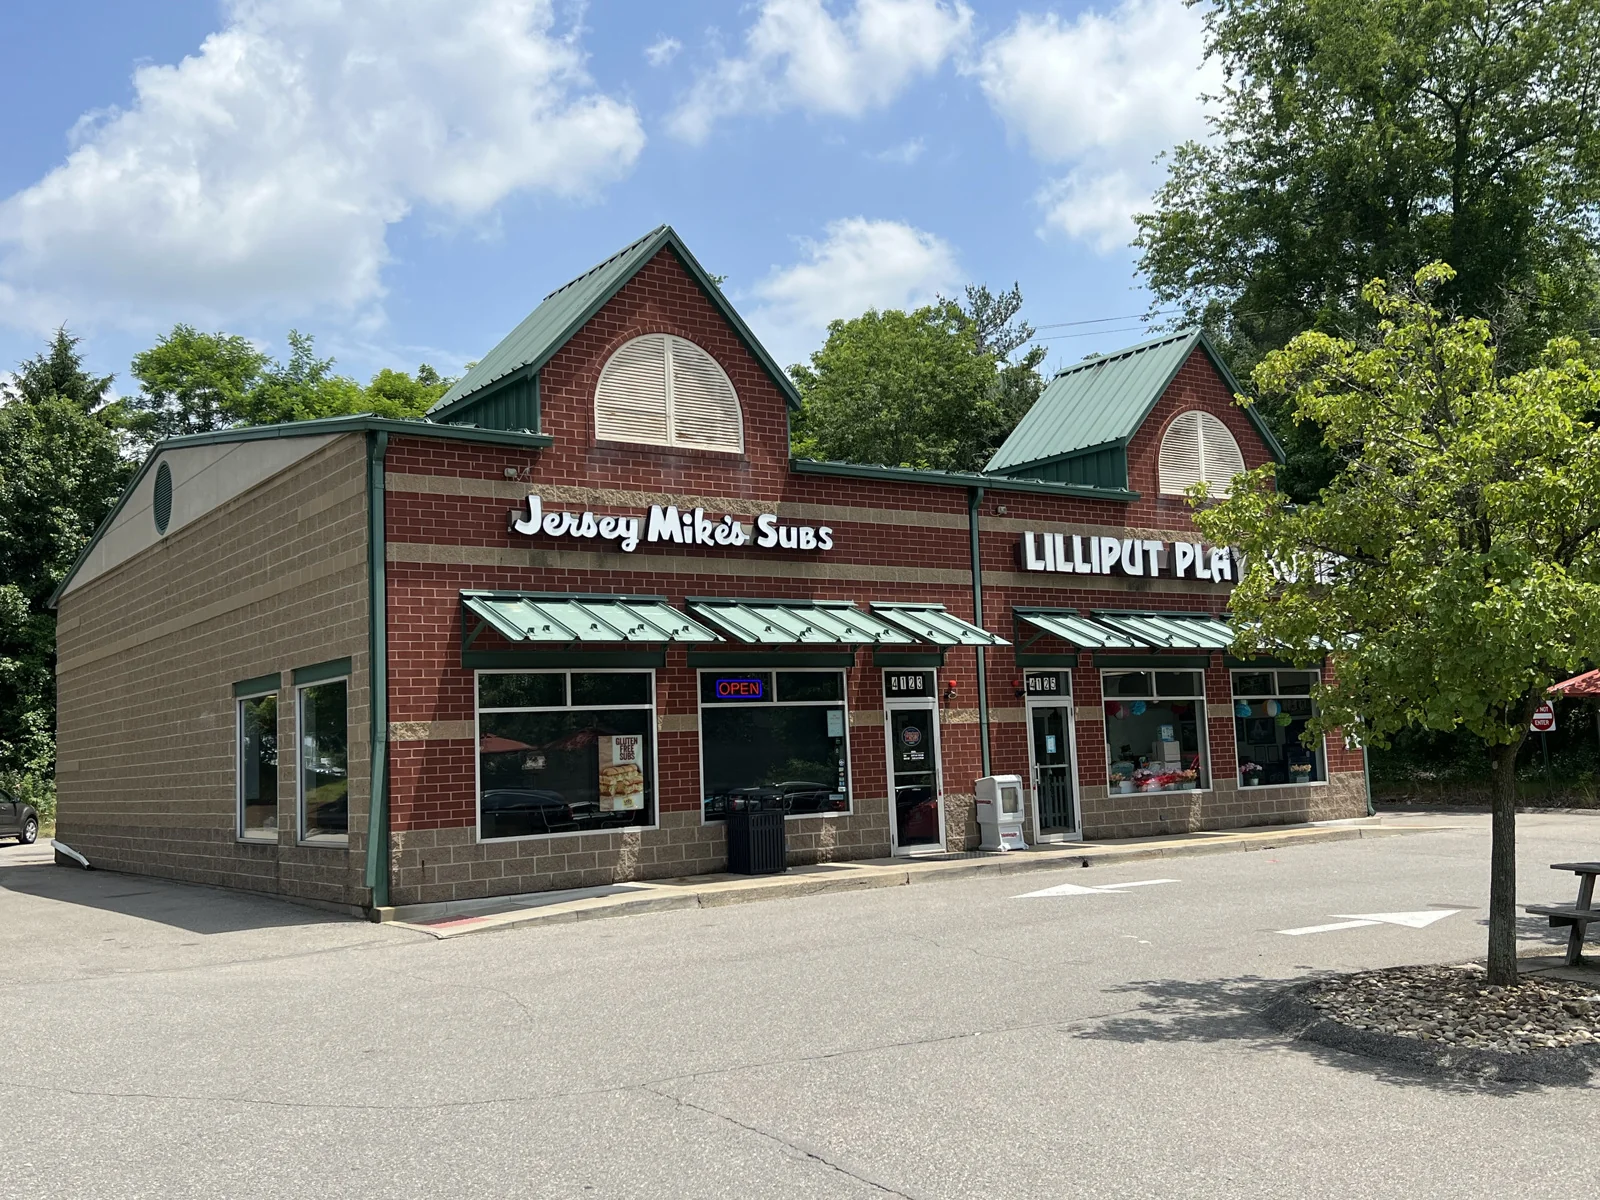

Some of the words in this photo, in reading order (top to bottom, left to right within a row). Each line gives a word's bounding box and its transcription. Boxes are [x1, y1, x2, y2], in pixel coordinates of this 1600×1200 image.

[514, 495, 640, 552] Jersey
[647, 504, 750, 547] Mike's
[1023, 530, 1164, 577] LILLIPUT
[719, 682, 759, 695] OPEN
[891, 676, 923, 690] 4123
[1029, 677, 1056, 690] 4125
[615, 737, 638, 745] GLUTEN
[620, 745, 635, 753] FREE
[620, 752, 635, 760] SUBS
